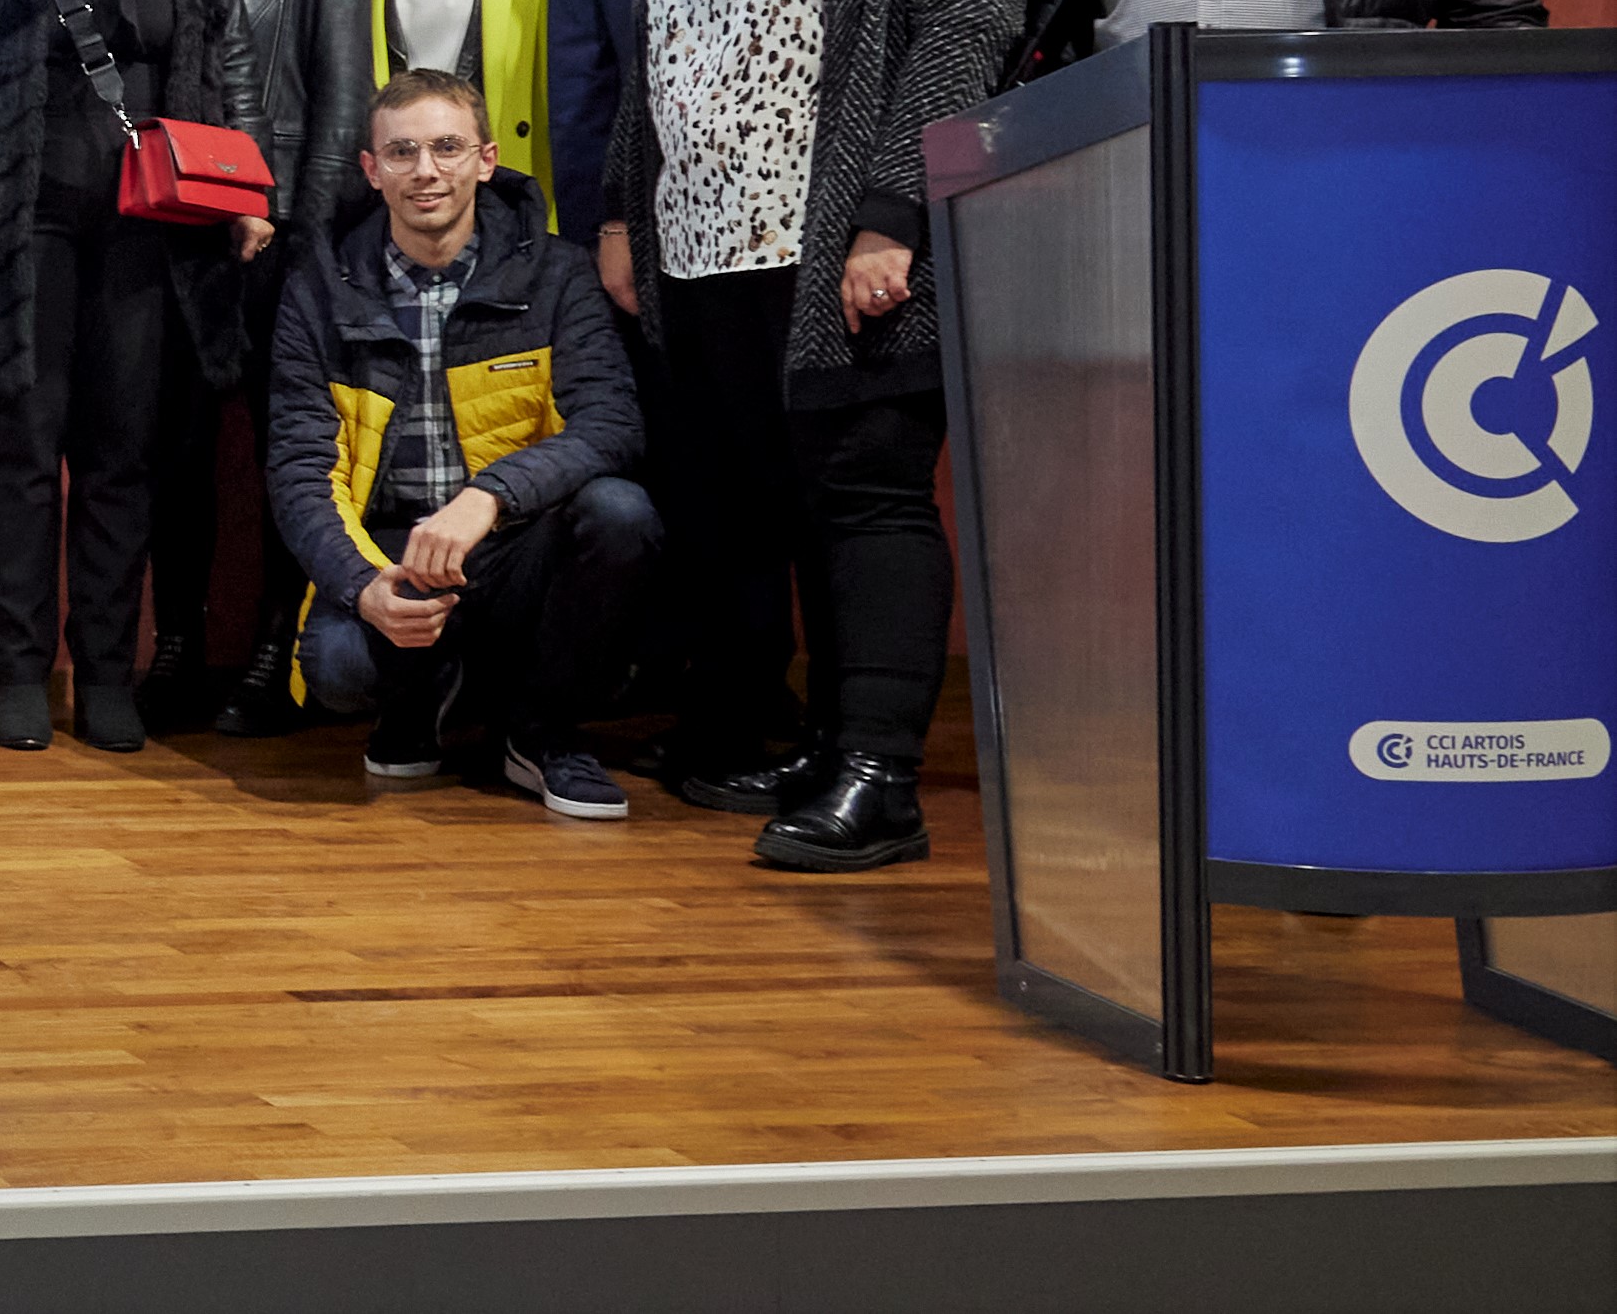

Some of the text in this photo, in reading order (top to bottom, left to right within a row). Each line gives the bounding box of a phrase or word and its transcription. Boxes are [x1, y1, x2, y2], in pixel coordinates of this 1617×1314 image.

[1427, 735, 1456, 750] CCI
[1462, 735, 1526, 750] ARTOIS
[1427, 751, 1585, 769] HAUTS-DE-FRANCE
